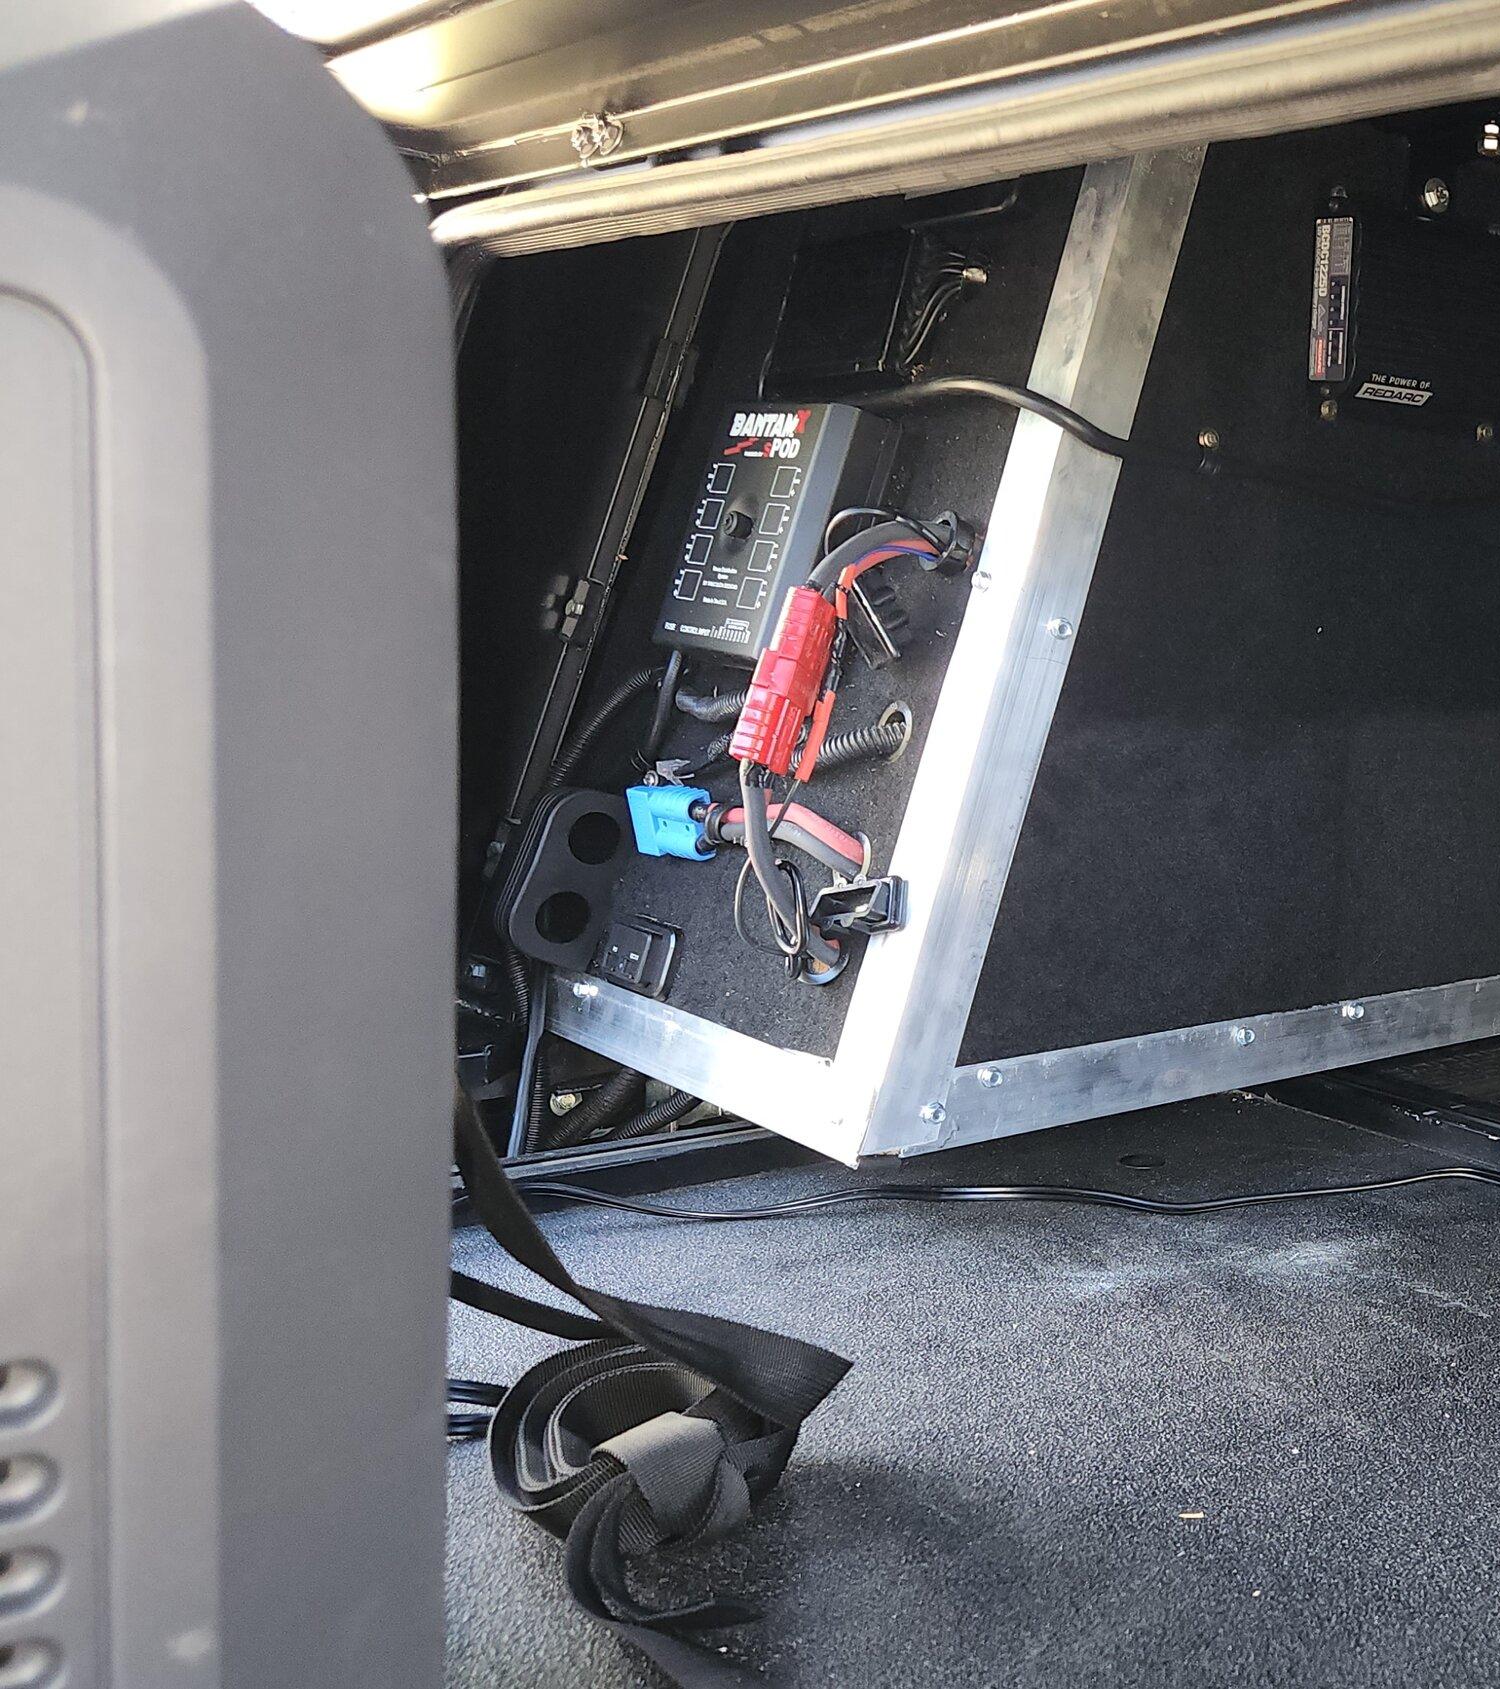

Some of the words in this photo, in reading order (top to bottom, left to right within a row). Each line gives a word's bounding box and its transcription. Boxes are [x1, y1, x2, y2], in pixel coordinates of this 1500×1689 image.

[1318, 224, 1331, 297] BCDC1225D
[1372, 373, 1387, 383] THE
[1389, 376, 1417, 388] POWER
[1420, 381, 1431, 390] OF
[1363, 387, 1424, 403] REDARC
